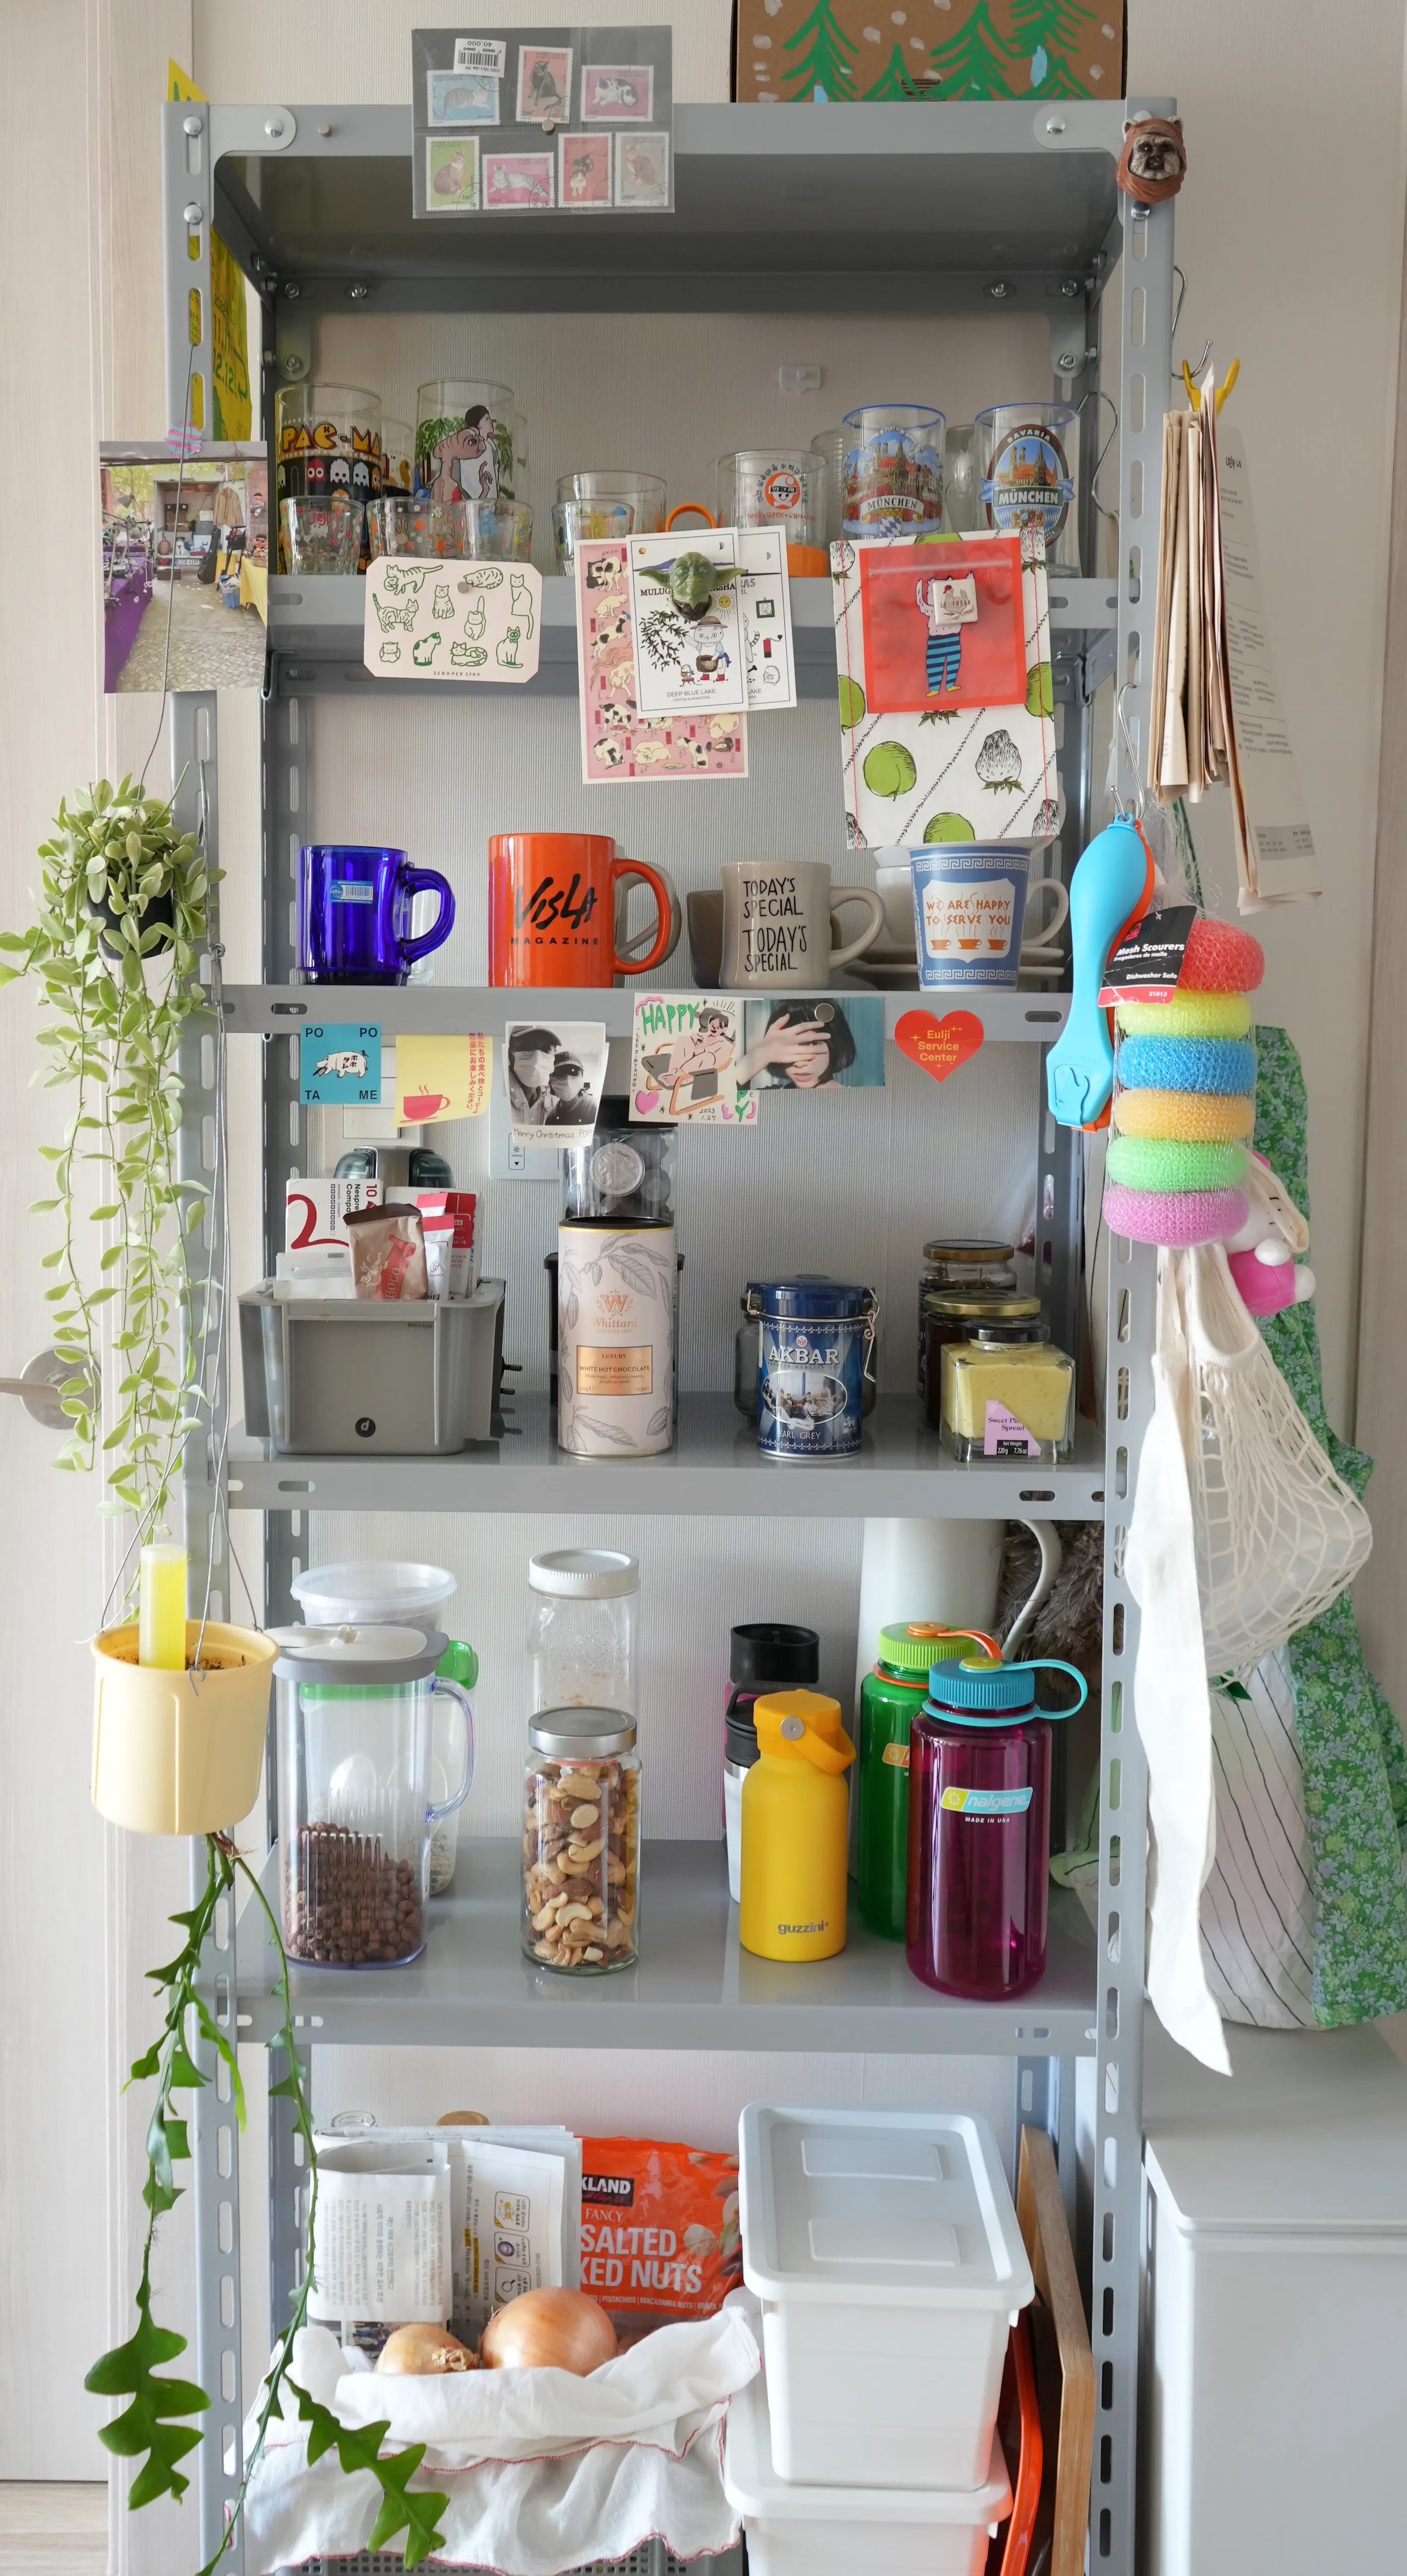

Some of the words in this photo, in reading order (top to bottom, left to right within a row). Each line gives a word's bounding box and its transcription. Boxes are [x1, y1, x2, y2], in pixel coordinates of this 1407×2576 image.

[1007, 429, 1050, 444] BAVARIA
[999, 488, 1059, 505] MÜNCHEN
[867, 497, 918, 510] MÜNCHEN
[743, 878, 796, 897] TODAY'S
[743, 896, 804, 918] SPECIAL
[927, 900, 943, 911] WE
[948, 899, 969, 910] ARE
[976, 899, 1011, 911] HAPPY
[926, 915, 941, 925] TO
[947, 915, 982, 925] SERVE
[989, 914, 1011, 926] YOU
[511, 937, 599, 945] MAGAZINE
[743, 926, 807, 952] TODAY'S
[1116, 945, 1140, 956] Mesh
[1142, 943, 1186, 952] Scourers
[744, 952, 798, 972] SPECIAL
[1114, 953, 1142, 962] Fregadores
[641, 1002, 700, 1035] HAPPY
[306, 1027, 324, 1038] PO
[359, 1027, 378, 1038] PO
[927, 1029, 951, 1042] Eulji
[918, 1041, 959, 1052] Service
[919, 1052, 957, 1062] Center
[305, 1090, 320, 1100] TA
[359, 1090, 378, 1100] ME
[513, 1128, 534, 1140] Merry
[536, 1129, 575, 1139] Christmas
[366, 1184, 378, 1197] 10
[345, 1184, 353, 1213] Compa
[385, 1267, 402, 1300] HOCO
[592, 1317, 638, 1328] Whittard
[768, 1346, 840, 1365] AKBAR
[780, 1430, 795, 1439] EARL
[800, 1432, 822, 1440] GREY
[968, 1793, 1029, 1811] nalgene
[778, 1920, 825, 1935] guzzini
[585, 2208, 623, 2223] FANCY
[631, 2260, 703, 2294] NUTS
[602, 2296, 636, 2304] PISTACHIOS
[640, 2296, 677, 2308] MACADAMIA
[677, 2301, 693, 2309] NUTS
